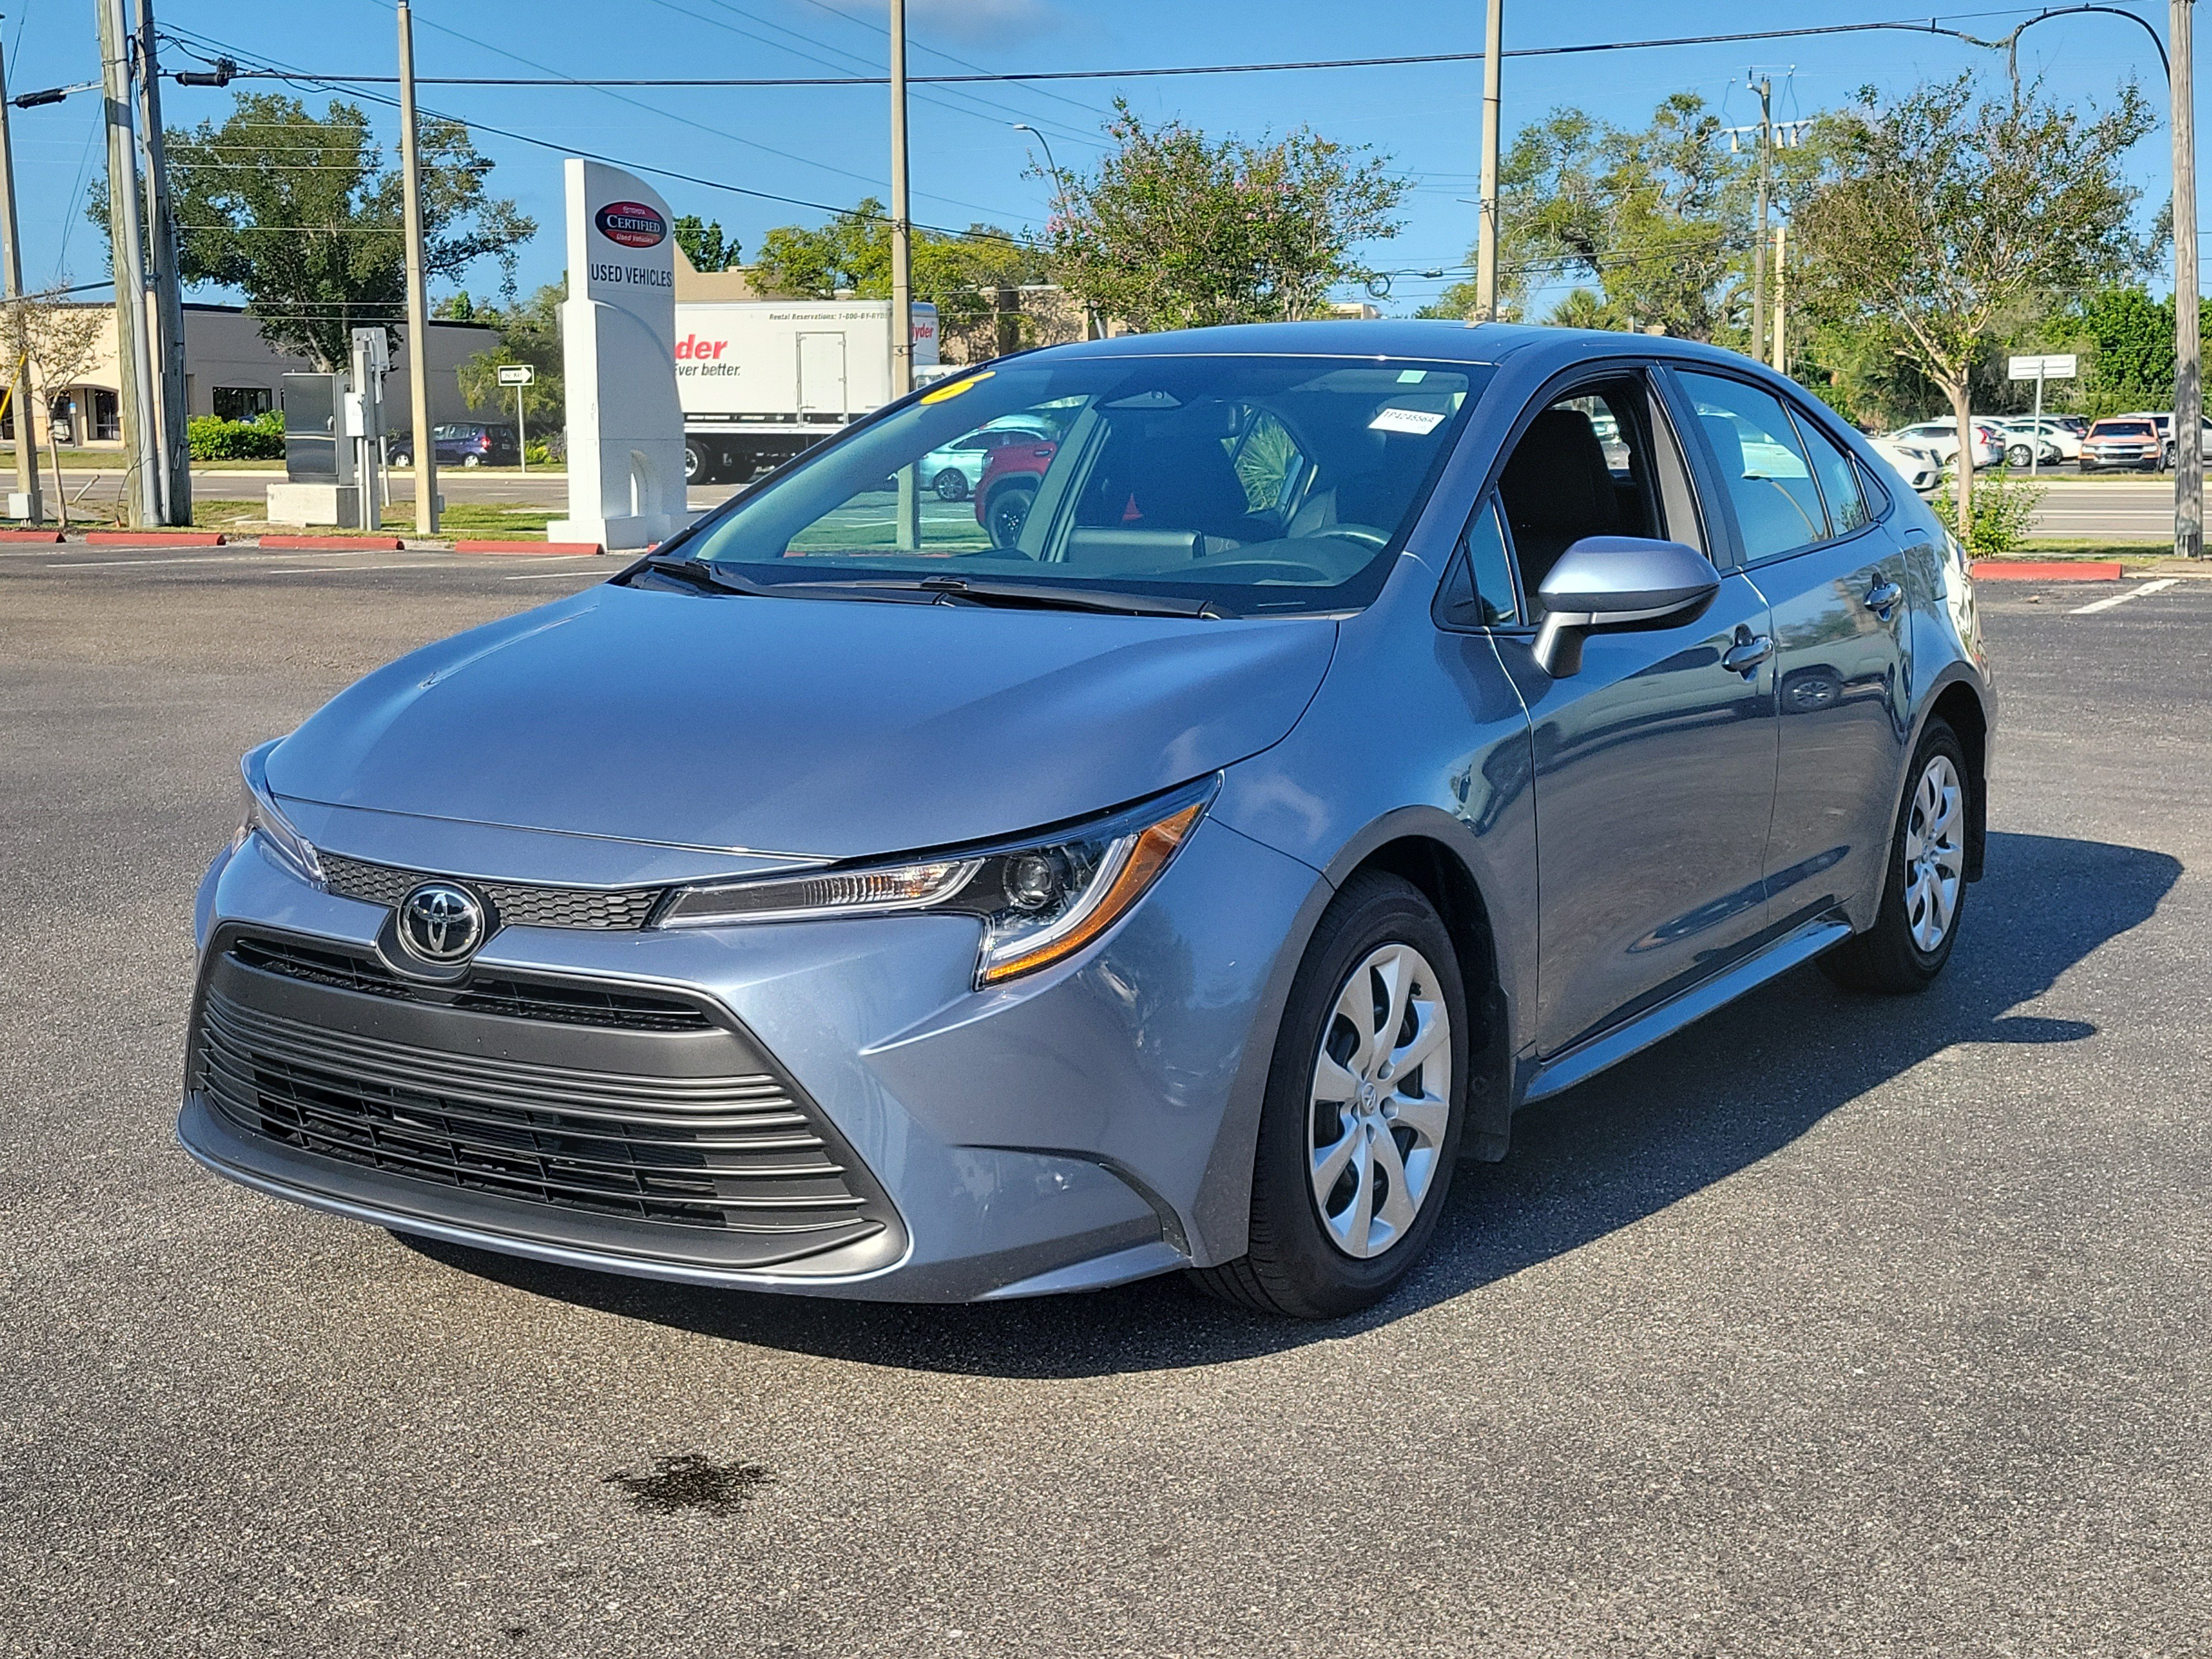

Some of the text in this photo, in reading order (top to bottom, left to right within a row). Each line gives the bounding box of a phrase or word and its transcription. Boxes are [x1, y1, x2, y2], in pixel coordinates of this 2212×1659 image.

[606, 215, 661, 232] CERTIFIED
[591, 263, 673, 287] USED VEHICLES
[701, 362, 741, 376] better.
